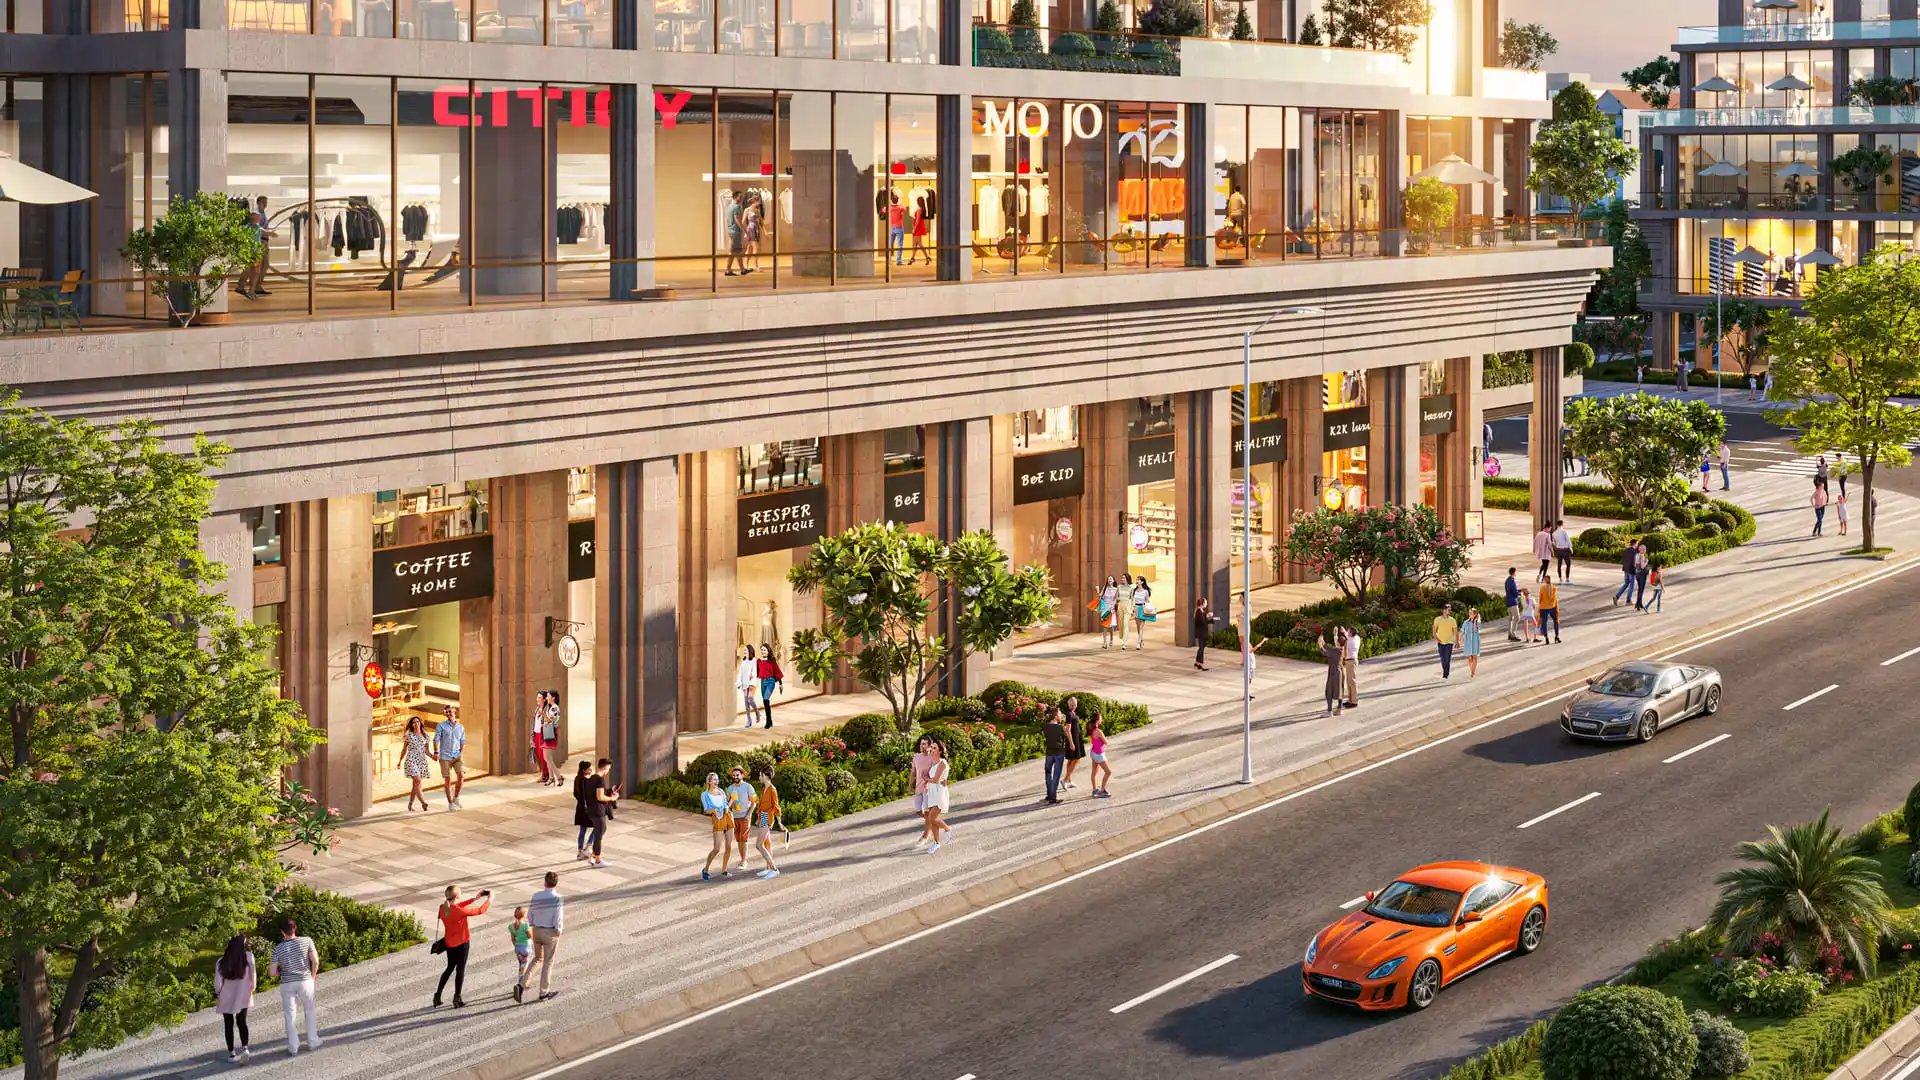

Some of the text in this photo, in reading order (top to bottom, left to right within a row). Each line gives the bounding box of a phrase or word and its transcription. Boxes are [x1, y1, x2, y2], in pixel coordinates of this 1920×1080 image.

[1329, 423, 1348, 437] K2K
[1234, 434, 1282, 453] HALTHY
[1137, 450, 1176, 468] HEALT
[1049, 467, 1074, 483] KID
[750, 503, 812, 526] RESPER
[748, 519, 816, 538] BEAUTIQUE
[579, 541, 596, 556] R
[410, 577, 458, 596] HOME
